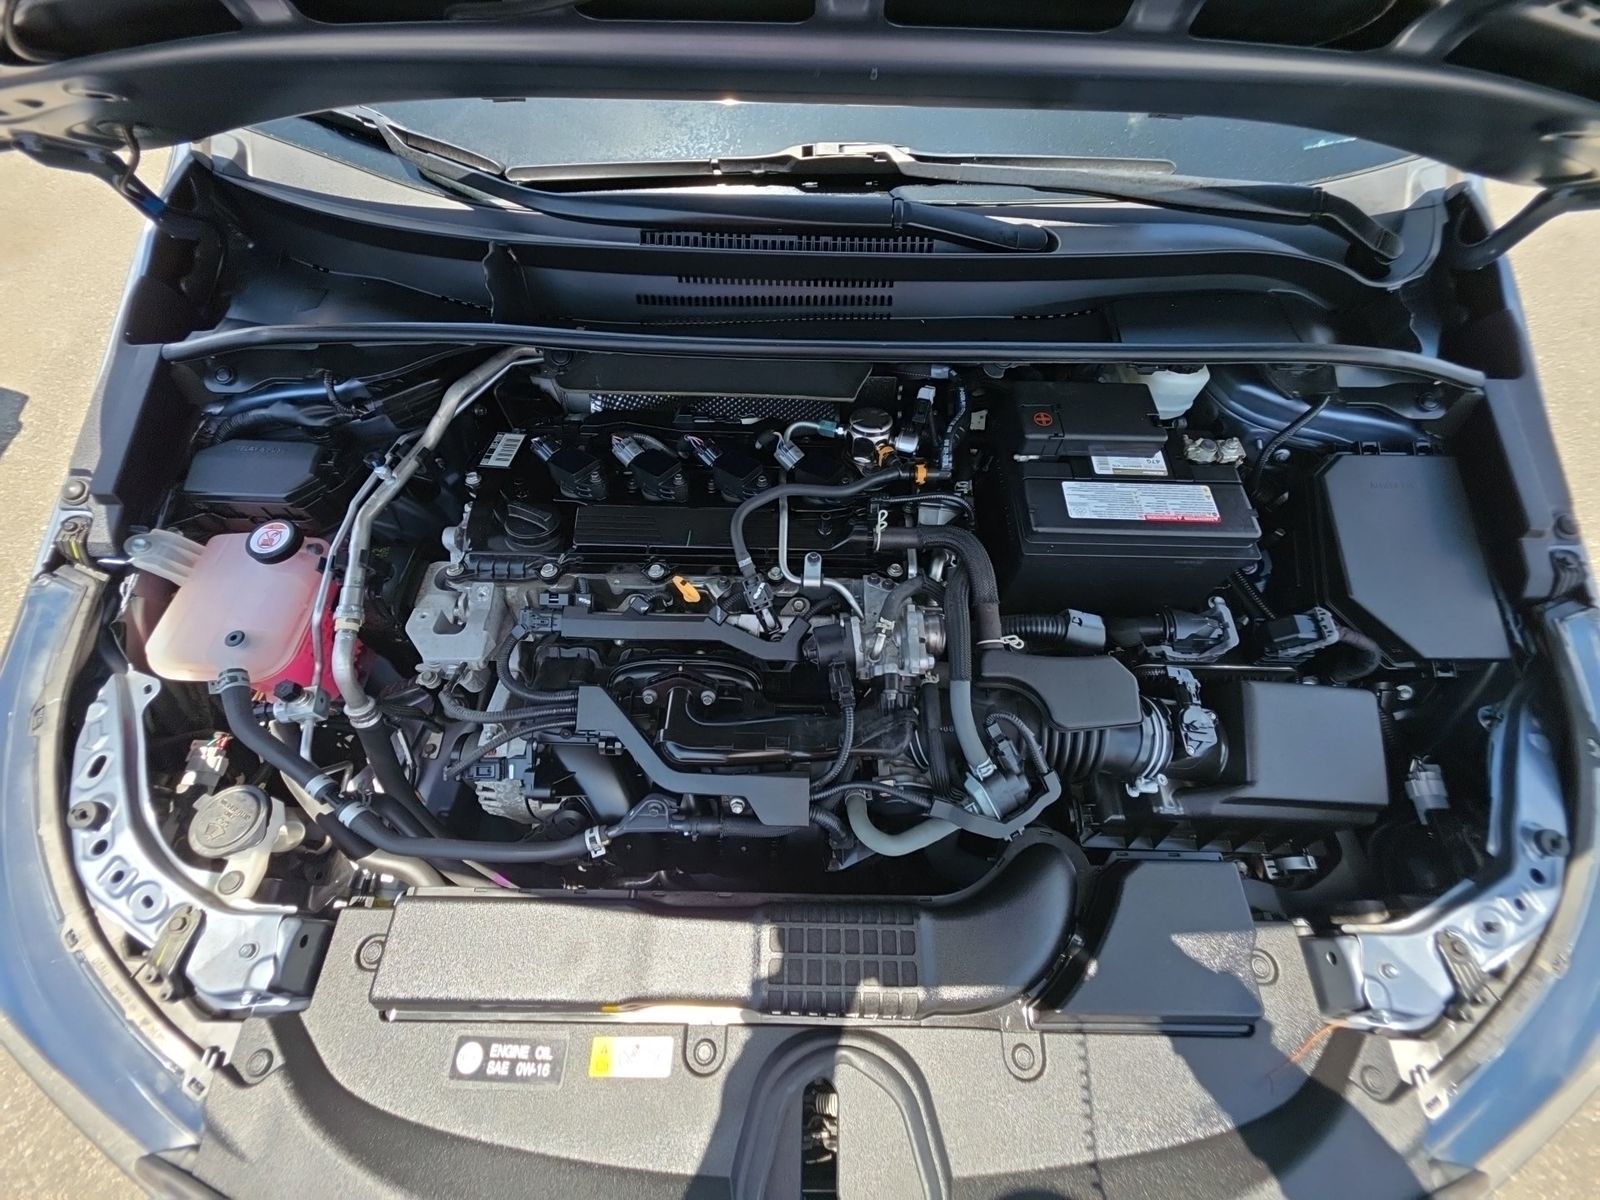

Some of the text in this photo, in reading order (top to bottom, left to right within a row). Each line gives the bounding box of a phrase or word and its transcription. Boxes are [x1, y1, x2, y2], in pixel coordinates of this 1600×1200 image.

[489, 1043, 531, 1060] ENGINE
[534, 1046, 554, 1061] OIL
[486, 1061, 551, 1077] SAE 0W-16
